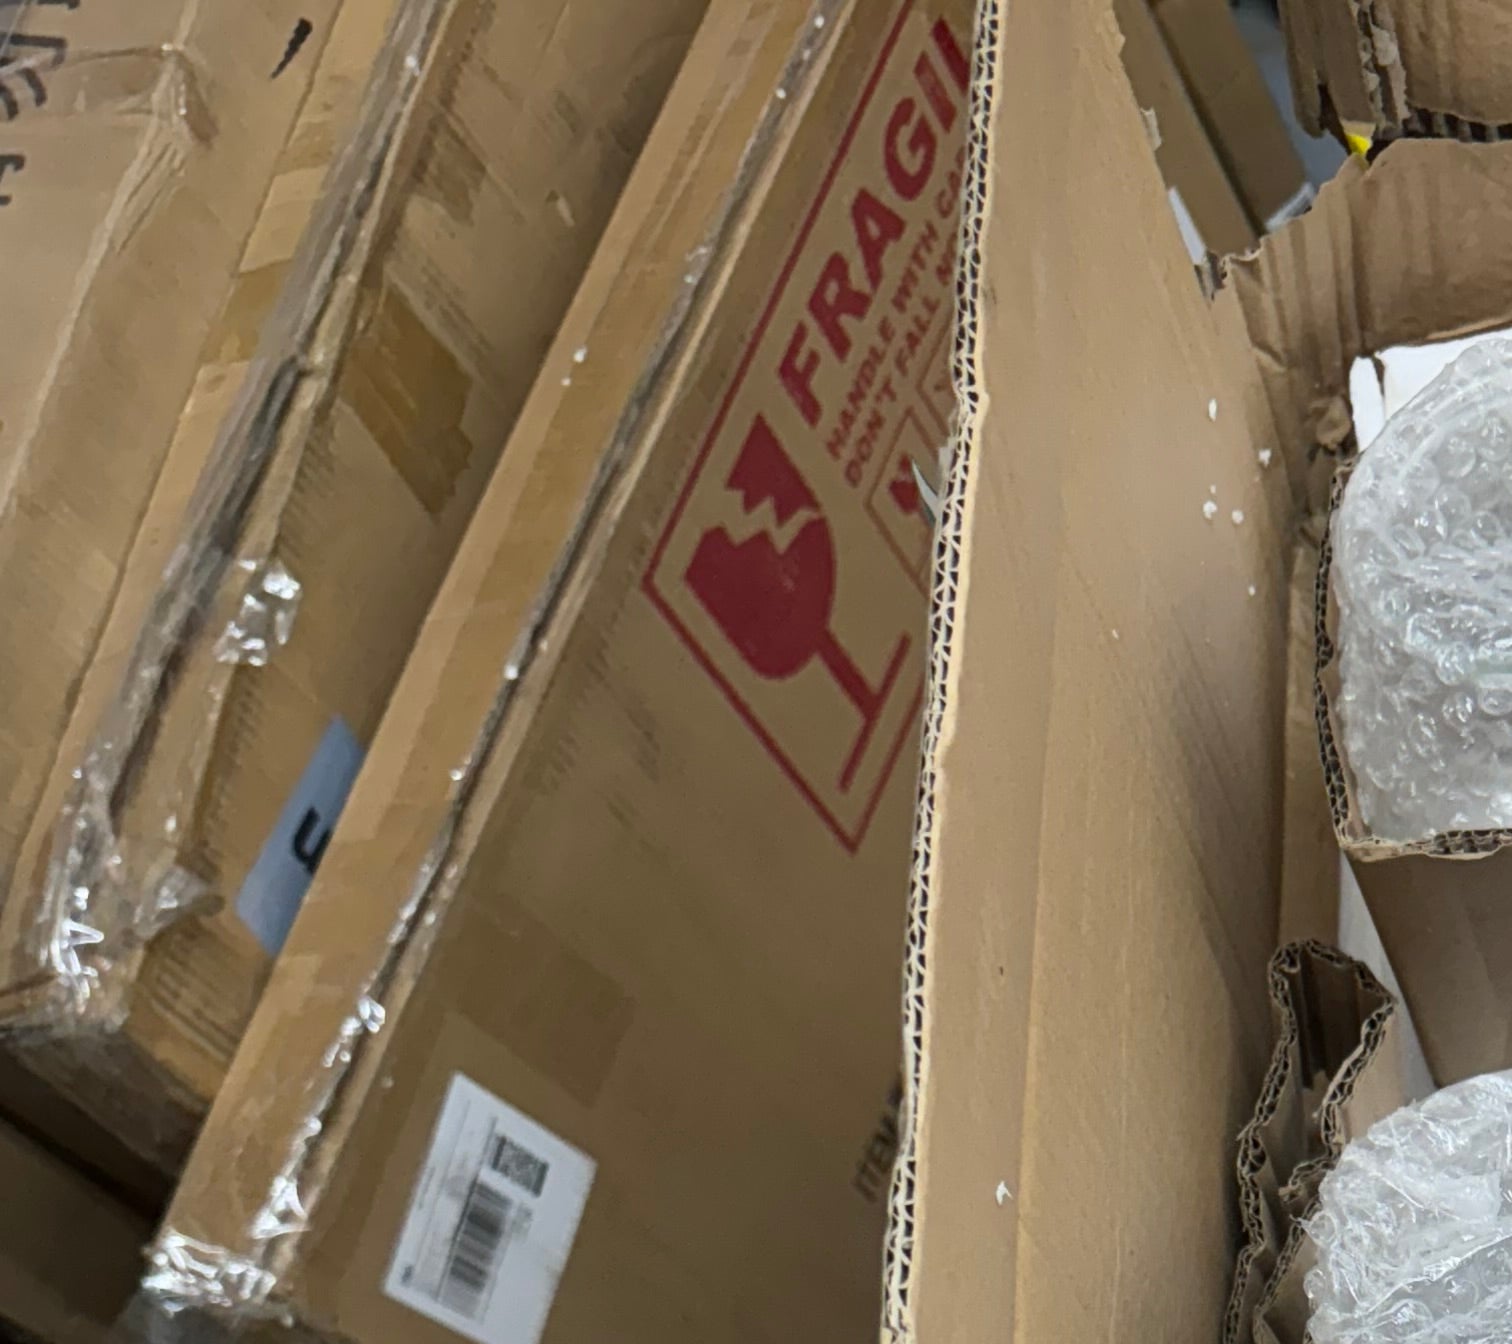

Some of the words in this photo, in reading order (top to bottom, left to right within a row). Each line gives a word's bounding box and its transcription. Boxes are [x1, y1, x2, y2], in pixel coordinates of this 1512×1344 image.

[776, 16, 970, 427] FRAGIL
[826, 315, 895, 461] HANDLE
[892, 219, 938, 314] WITH
[844, 373, 897, 489] DON'T
[895, 296, 940, 377] FALL
